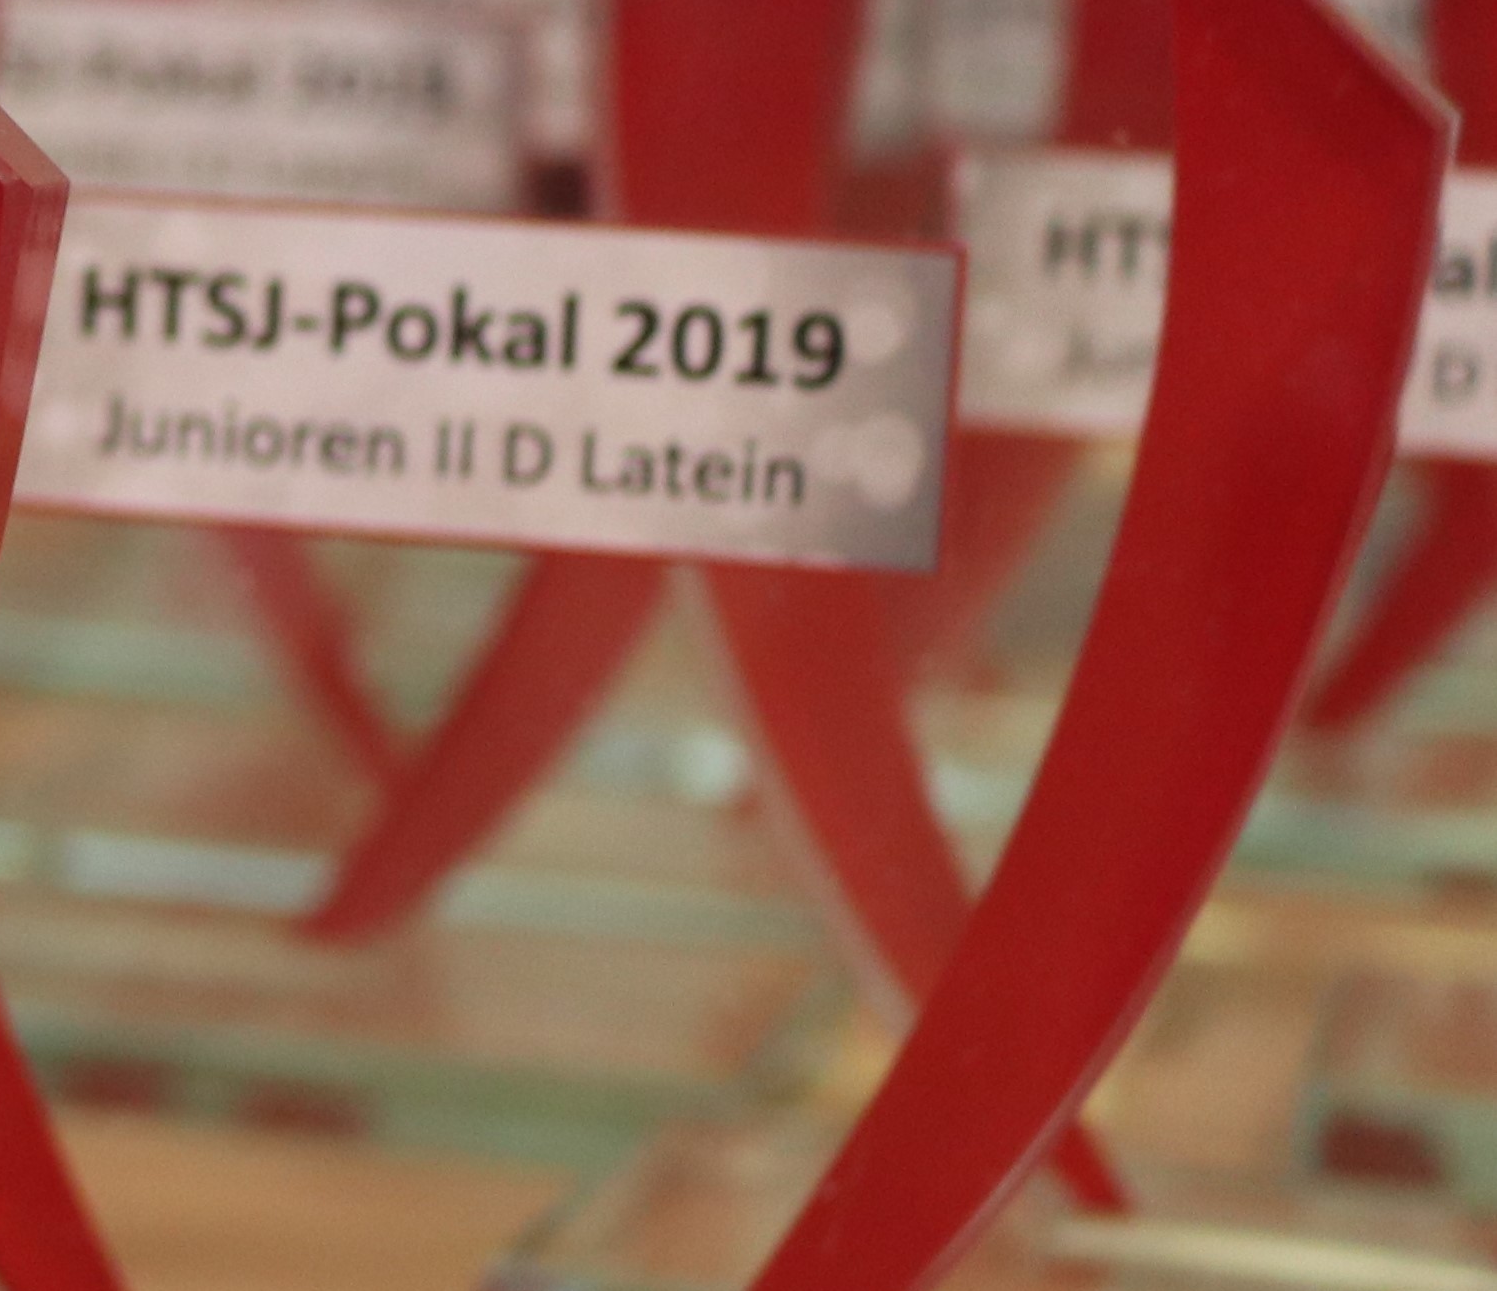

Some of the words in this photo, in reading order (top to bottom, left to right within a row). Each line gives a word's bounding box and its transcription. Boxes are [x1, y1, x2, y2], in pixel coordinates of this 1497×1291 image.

[76, 264, 581, 372] HTSJ-Pokal
[608, 296, 852, 396] 2019
[97, 392, 408, 479] Junioren
[499, 420, 557, 492] D
[578, 429, 809, 510] Latein
